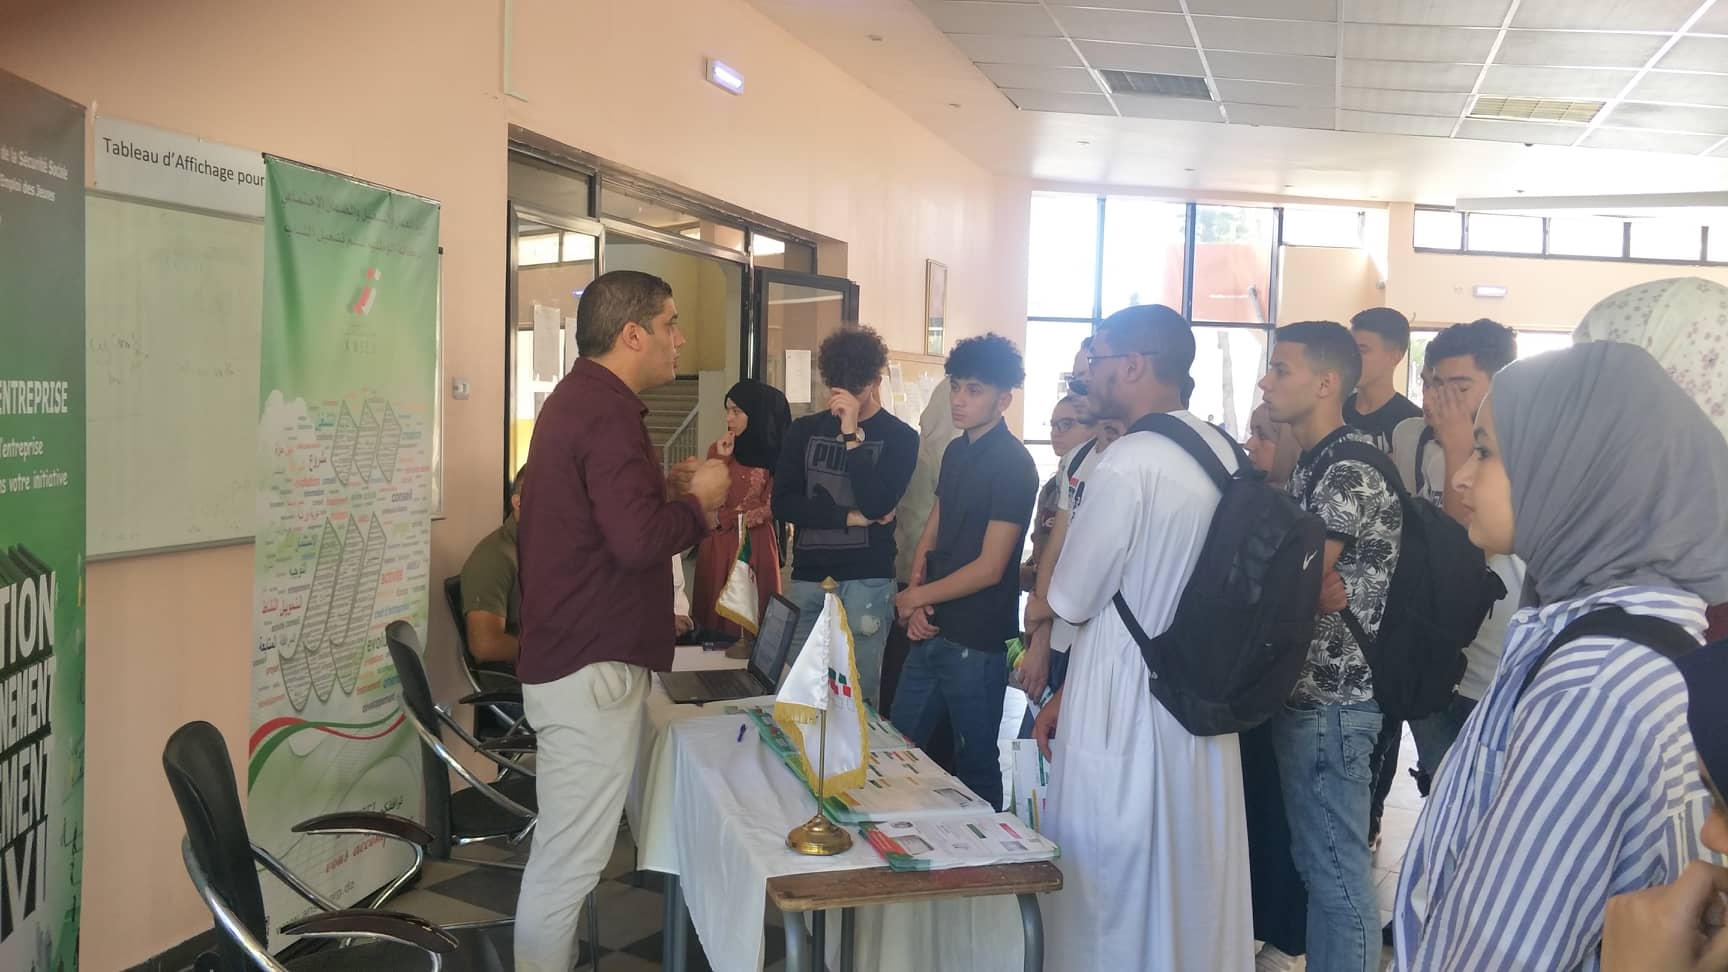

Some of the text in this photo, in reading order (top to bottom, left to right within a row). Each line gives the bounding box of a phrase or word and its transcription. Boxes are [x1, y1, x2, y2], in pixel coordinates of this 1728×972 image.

[103, 137, 159, 164] Tableau
[237, 172, 264, 186] pour
[9, 473, 31, 492] votre
[33, 468, 68, 489] initiative
